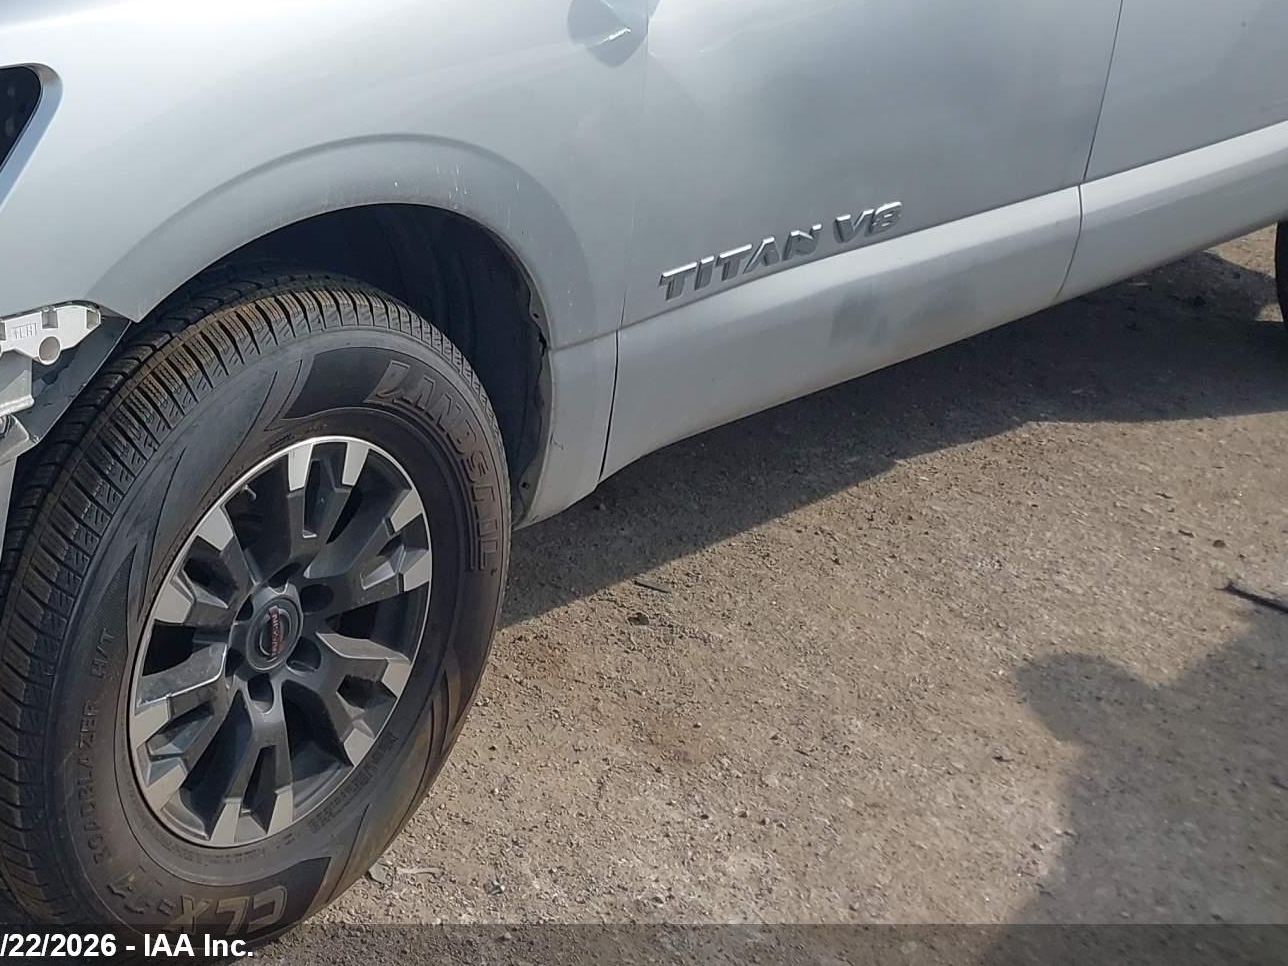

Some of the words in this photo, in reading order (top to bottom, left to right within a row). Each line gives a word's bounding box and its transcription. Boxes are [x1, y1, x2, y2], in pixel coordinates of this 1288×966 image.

[657, 224, 823, 300] TITAN
[834, 201, 903, 244] V8
[364, 359, 499, 570] LANDSAIL
